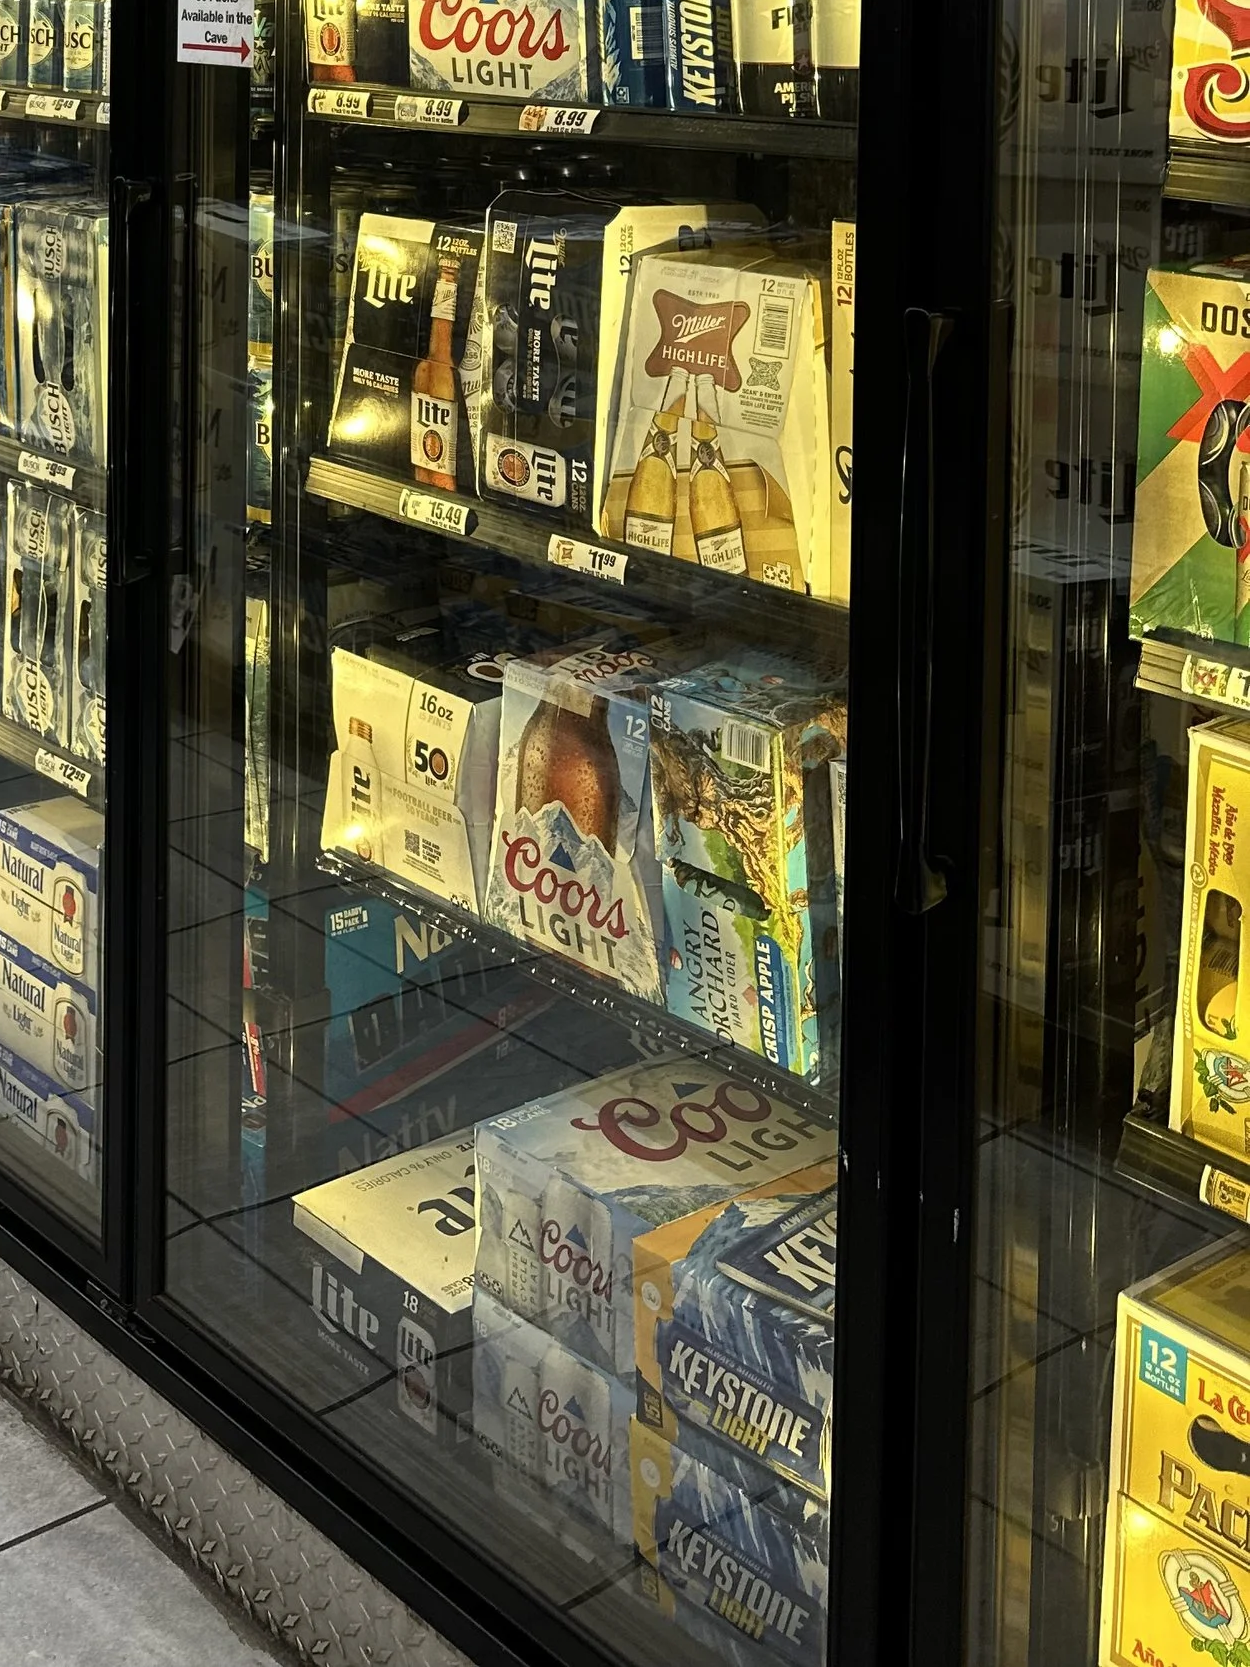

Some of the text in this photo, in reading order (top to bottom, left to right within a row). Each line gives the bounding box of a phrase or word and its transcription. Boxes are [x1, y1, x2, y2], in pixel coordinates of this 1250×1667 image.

[181, 9, 253, 25] Available in the
[205, 31, 228, 44] Cave
[452, 57, 534, 91] LIGHT
[436, 235, 451, 251] 12
[360, 265, 418, 310] Lite
[525, 237, 558, 311] Lite
[760, 278, 776, 293] 12
[837, 286, 854, 307] 12
[672, 313, 727, 343] Miller
[662, 345, 727, 369] HIGH LIFE
[353, 367, 399, 387] MORE TASTE
[46, 382, 67, 456] BUSCH
[415, 398, 451, 428] Lite
[531, 449, 558, 503] Lite
[572, 458, 588, 484] 12
[28, 508, 44, 560] BUSCH
[627, 529, 670, 550] HIGH LIFE
[702, 544, 743, 566] HIGH LIFE
[29, 658, 43, 732] BUSCH
[420, 691, 436, 714] 16
[625, 714, 647, 741] 12
[414, 742, 452, 783] 50
[393, 788, 453, 824] FOOTBALL BEER
[415, 808, 440, 827] YEARS
[1225, 801, 1239, 827] Año
[1, 842, 45, 895] Natural
[502, 830, 629, 939] Coors
[10, 889, 30, 918] Light
[54, 921, 83, 953] Natural
[519, 895, 618, 971] LIGHT
[2, 957, 46, 1014] Natural
[682, 919, 711, 1022] ANGRY
[701, 909, 736, 1050] ORCHARD
[725, 949, 744, 1030] HARD CIDER
[755, 940, 780, 1065] CRISP APPLE
[1184, 975, 1194, 1041] CARDBOARD
[12, 1005, 34, 1037] Light
[57, 1040, 86, 1072] Natural
[489, 1115, 518, 1131] 18
[570, 1079, 773, 1163] Coo
[355, 1160, 417, 1193] CALORIES
[539, 1218, 614, 1306] Coors
[310, 1260, 381, 1351] Lite
[403, 1290, 420, 1314] 18
[546, 1271, 616, 1335] LIGHT
[341, 1346, 372, 1378] TASTE
[400, 1318, 436, 1369] Lite
[1147, 1337, 1178, 1375] 12
[1144, 1371, 1181, 1398] BOTTLES
[1154, 1365, 1182, 1388] FL OZ
[670, 1339, 813, 1460] KEYSTONE
[538, 1386, 614, 1477] Coors
[712, 1402, 773, 1458] LIGHT
[543, 1448, 614, 1512] LIGHT
[667, 1518, 811, 1647] KEYSTONE
[709, 1585, 767, 1643] LIGHT
